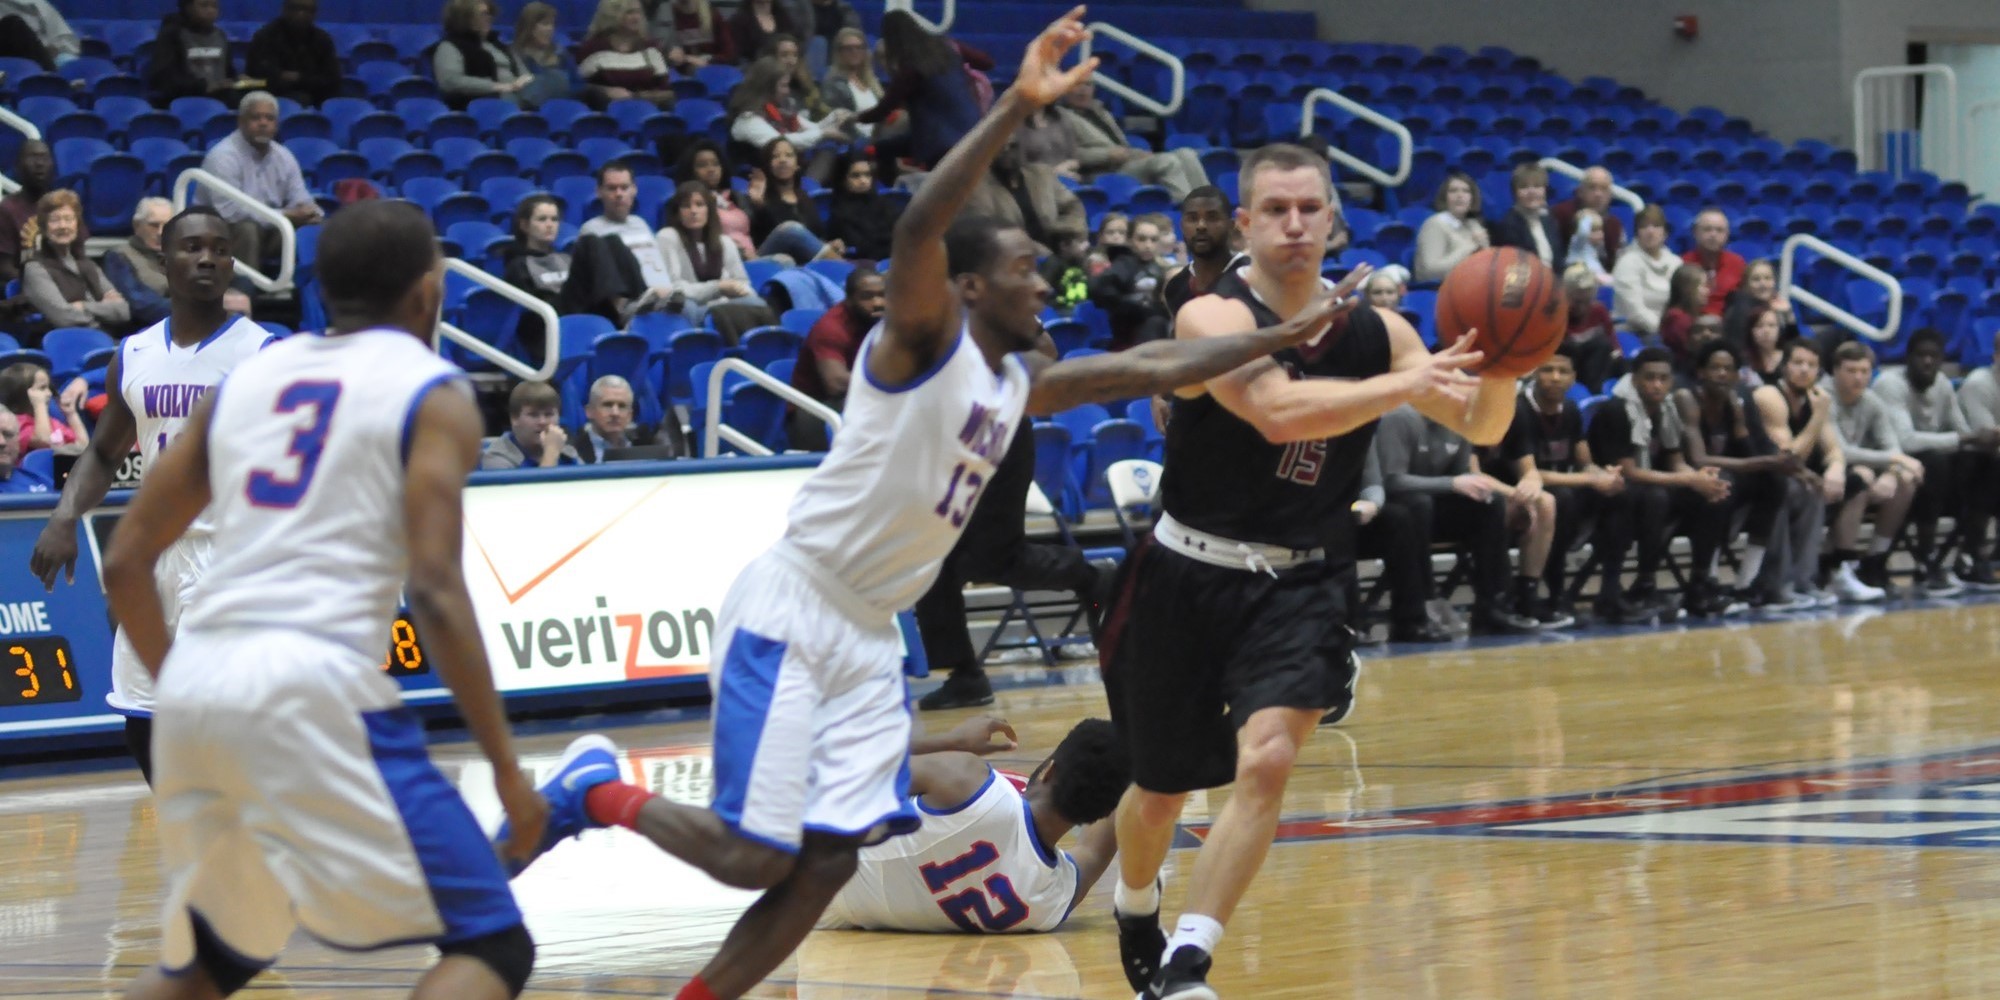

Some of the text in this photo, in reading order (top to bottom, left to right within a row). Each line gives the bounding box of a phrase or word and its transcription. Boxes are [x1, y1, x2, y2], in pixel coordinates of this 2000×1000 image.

[245, 379, 343, 509] 3
[1276, 438, 1327, 486] 15
[9, 646, 72, 698] 31
[500, 596, 714, 680] verizon
[918, 840, 1030, 933] 12
